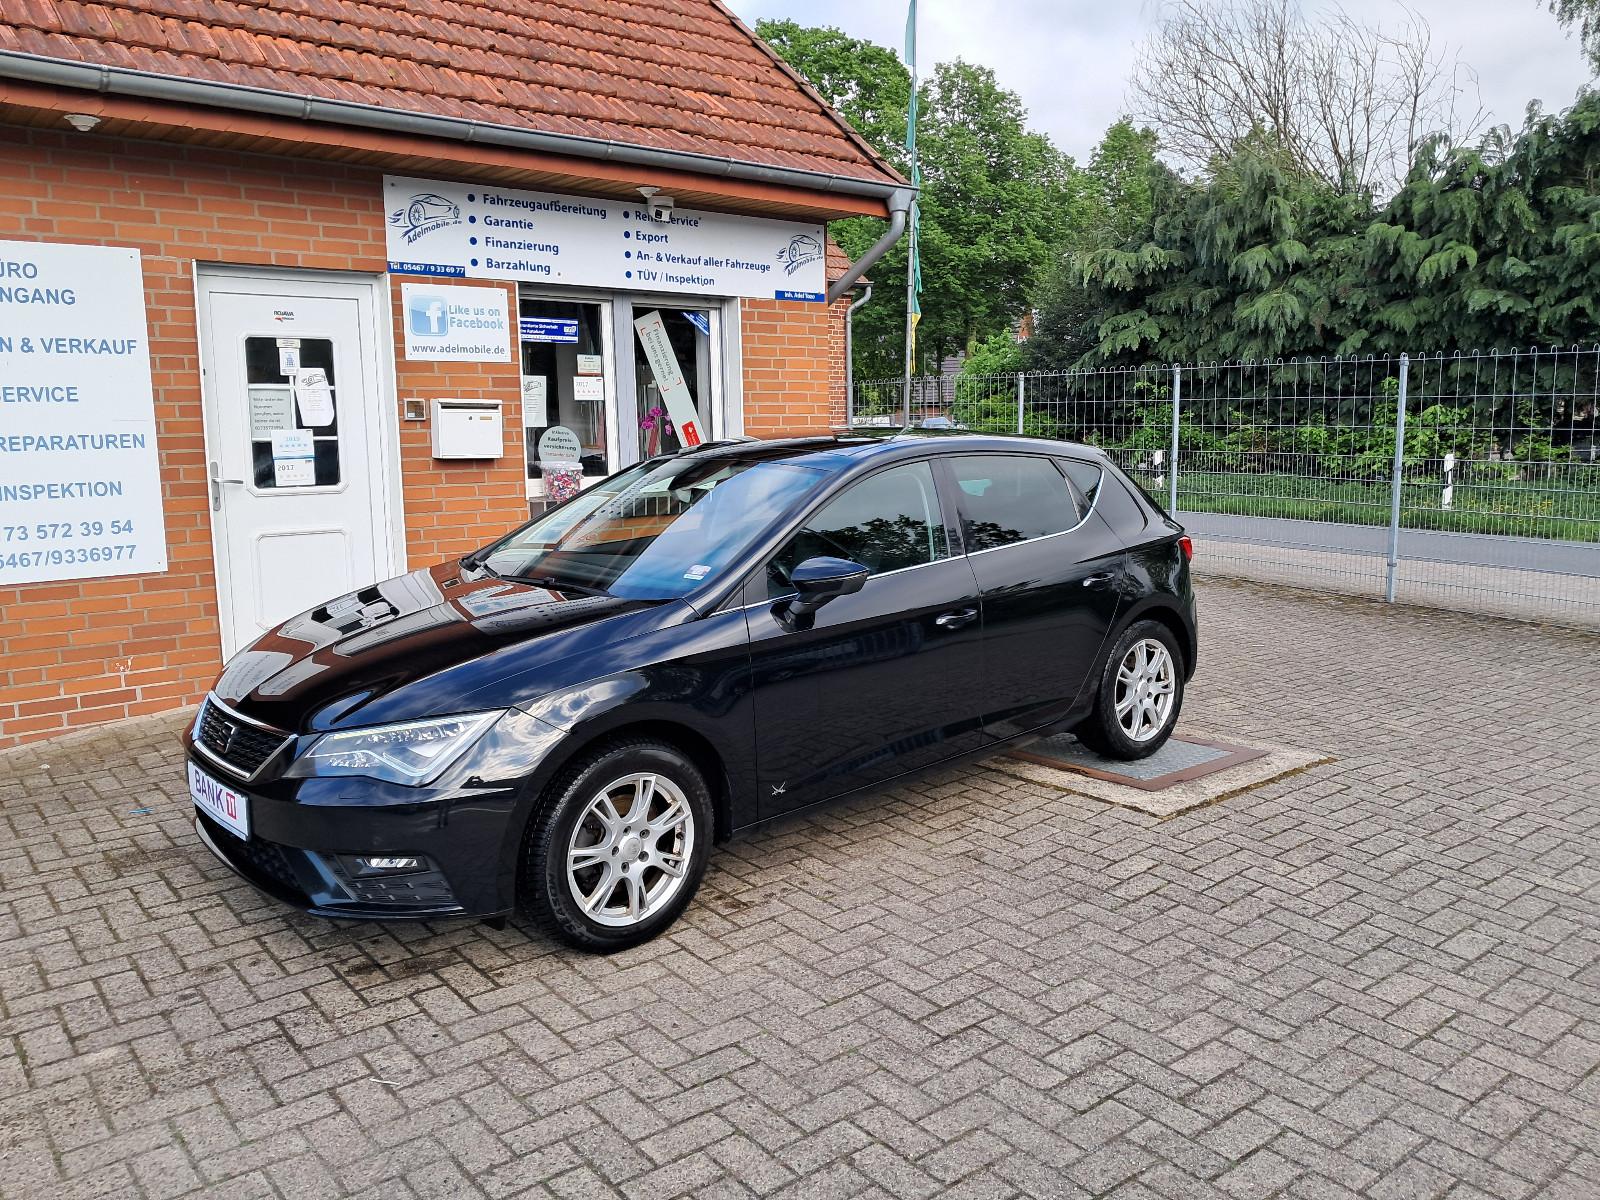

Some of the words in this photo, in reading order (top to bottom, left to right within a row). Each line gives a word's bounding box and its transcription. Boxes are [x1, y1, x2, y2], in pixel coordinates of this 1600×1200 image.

[482, 193, 607, 219] Fahrzeugaufbereitung
[484, 215, 534, 230] Garantie
[635, 210, 699, 227] Reiervice
[407, 219, 462, 246] Adelmobile.de
[636, 231, 669, 243] Export
[485, 236, 559, 256] Finanzierung
[486, 258, 551, 275] Barzahlung
[636, 250, 654, 261] An-
[656, 252, 663, 262] &
[665, 252, 702, 266] Verkauf
[703, 256, 724, 268] aller
[725, 258, 771, 272] Fahrzeuge
[637, 269, 658, 281] TÜV
[659, 272, 664, 282] /
[666, 272, 715, 287] Inspektion
[0, 286, 76, 305] NGANG
[449, 305, 470, 315] Like
[474, 307, 484, 315] us
[488, 308, 500, 316] on
[449, 317, 504, 329] Facebook
[20, 337, 35, 353] &
[40, 338, 137, 354] VERKAUF
[412, 344, 505, 355] www.adelmobile.de
[650, 344, 658, 357] uns
[653, 328, 673, 376] Finanzierung
[0, 387, 79, 402] ERVICE
[0, 433, 145, 452] REPARATUREN
[3, 526, 29, 541] 73
[36, 523, 73, 539] 572
[80, 521, 104, 536] 39
[110, 520, 134, 535] 54
[194, 769, 225, 813] BANK
